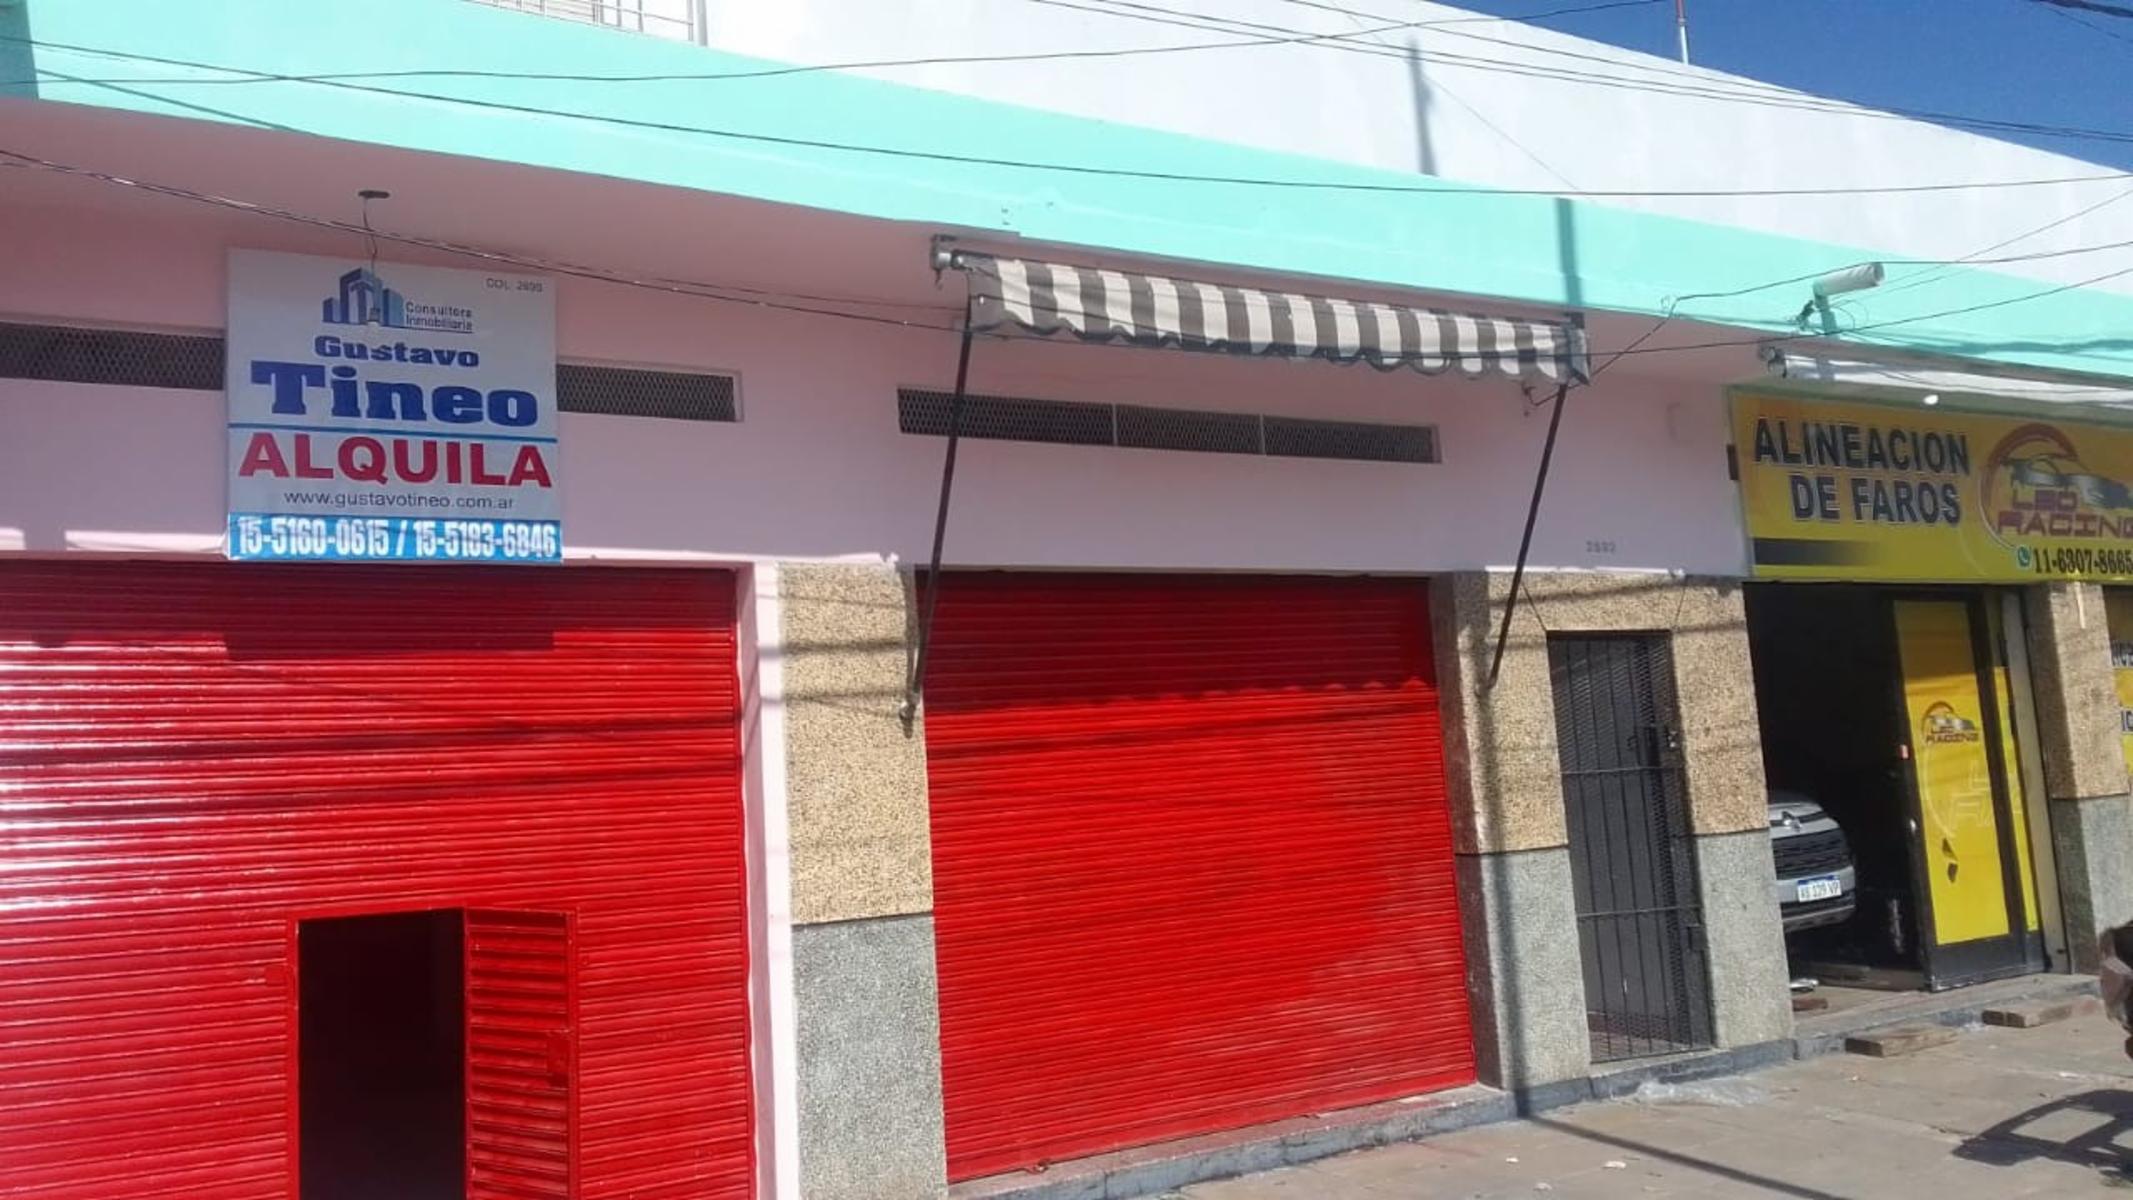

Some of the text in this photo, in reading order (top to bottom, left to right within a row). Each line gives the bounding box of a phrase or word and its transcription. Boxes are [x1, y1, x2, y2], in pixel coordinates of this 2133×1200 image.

[406, 301, 473, 318] Consultora
[406, 314, 473, 331] Inmobiliaria
[314, 335, 479, 367] Gustavo
[250, 360, 538, 427] Tineo
[238, 432, 552, 488] ALQUILA
[1754, 418, 1971, 477] ALINEACION
[284, 491, 513, 510] www.gustavotineo.com.ar
[1790, 473, 1962, 527] DE FAROS
[2012, 486, 2077, 511] LED
[238, 516, 389, 556] 15-5160-0615
